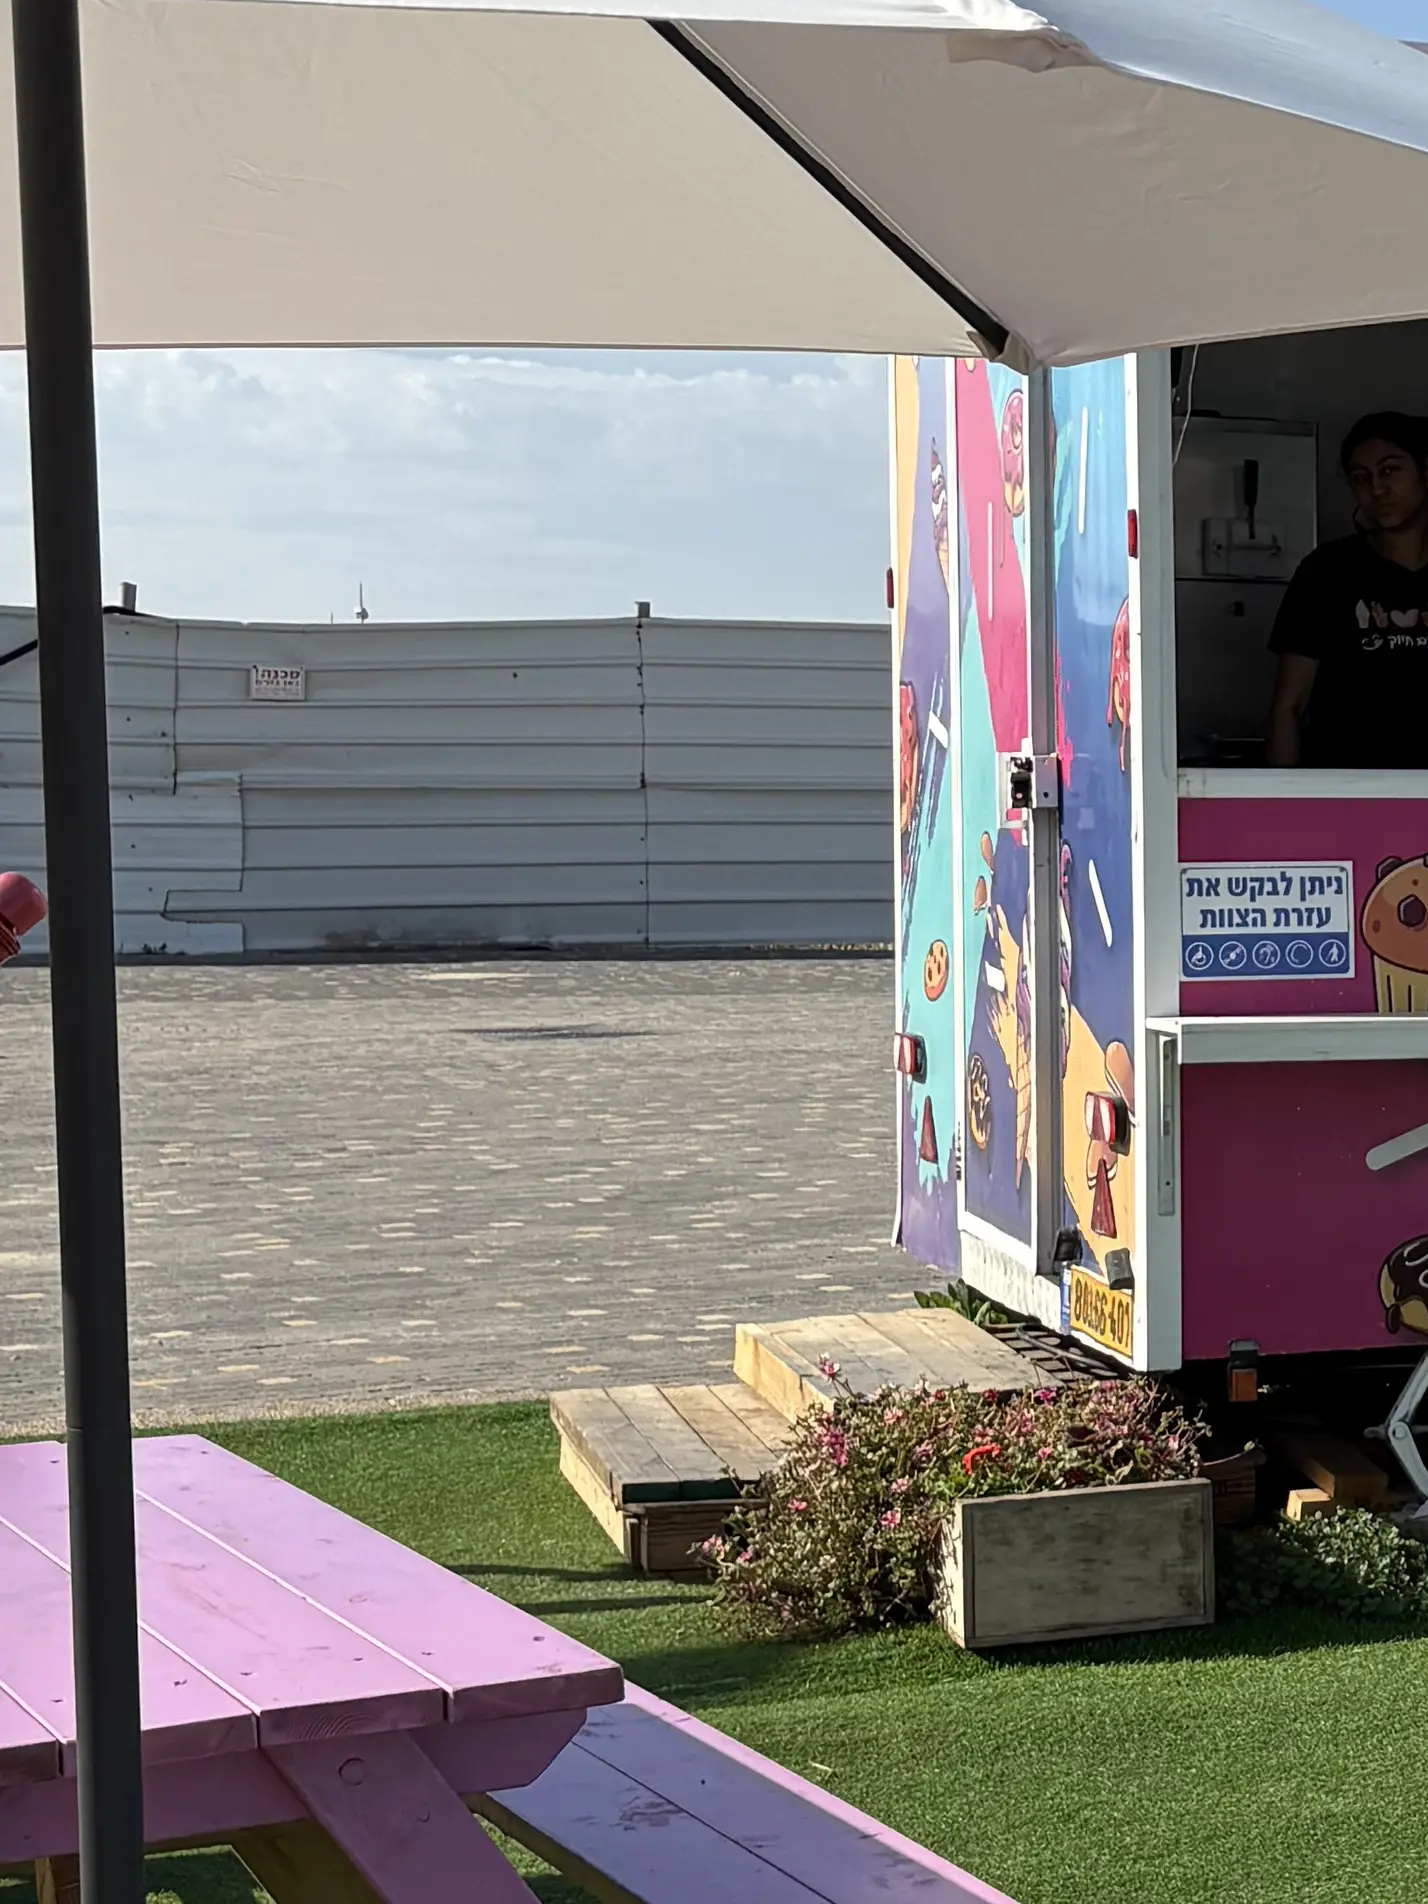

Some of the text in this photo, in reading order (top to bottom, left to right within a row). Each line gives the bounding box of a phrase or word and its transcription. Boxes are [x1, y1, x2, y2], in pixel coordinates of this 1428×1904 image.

[1186, 871, 1344, 902] ניתן לבקש את
[1199, 907, 1332, 929] עזרת הצוות
